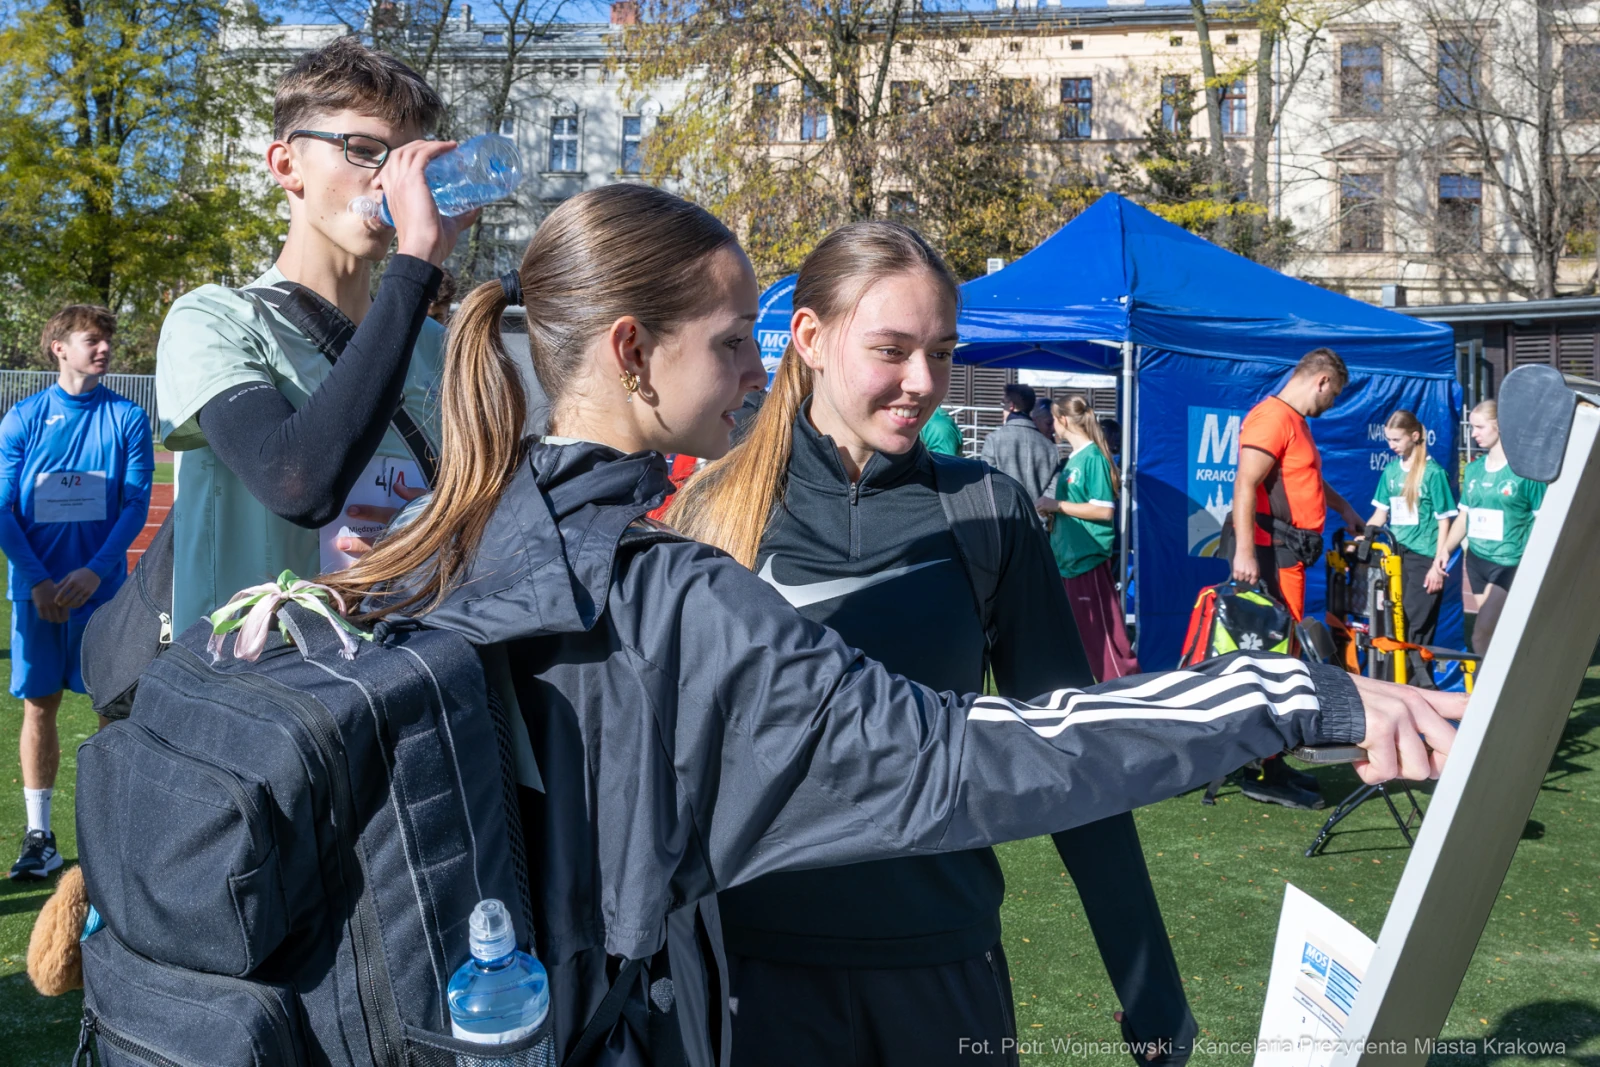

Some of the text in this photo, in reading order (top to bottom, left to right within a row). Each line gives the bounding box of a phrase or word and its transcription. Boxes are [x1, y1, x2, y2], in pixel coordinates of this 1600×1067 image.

[761, 333, 791, 348] MO
[1197, 413, 1240, 465] M
[60, 475, 81, 488] 4/2
[1196, 467, 1237, 482] KRAKÓ
[1305, 945, 1328, 967] MOS
